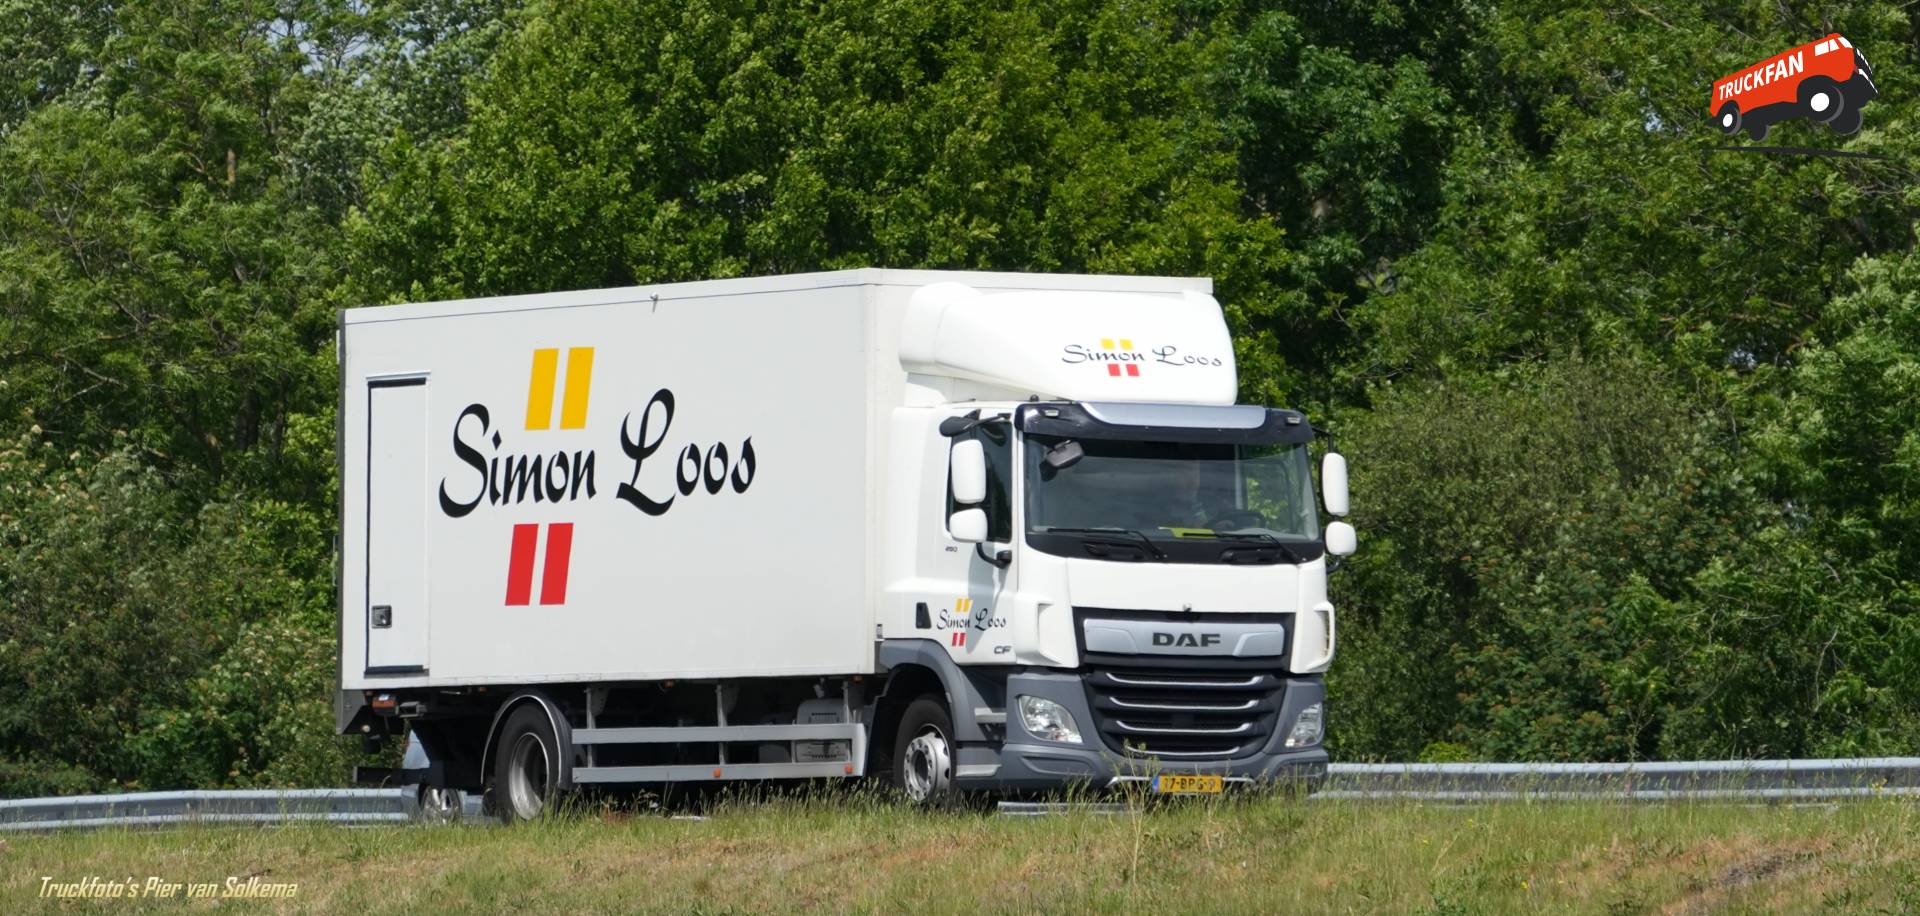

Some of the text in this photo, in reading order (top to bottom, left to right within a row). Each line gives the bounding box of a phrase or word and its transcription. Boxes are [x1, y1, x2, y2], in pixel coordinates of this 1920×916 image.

[1061, 344, 1222, 367] Simon Loos
[439, 388, 757, 518] Simon Loos
[936, 607, 1007, 631] Simon Loos
[993, 645, 1012, 655] CF
[1152, 632, 1221, 647] DAF
